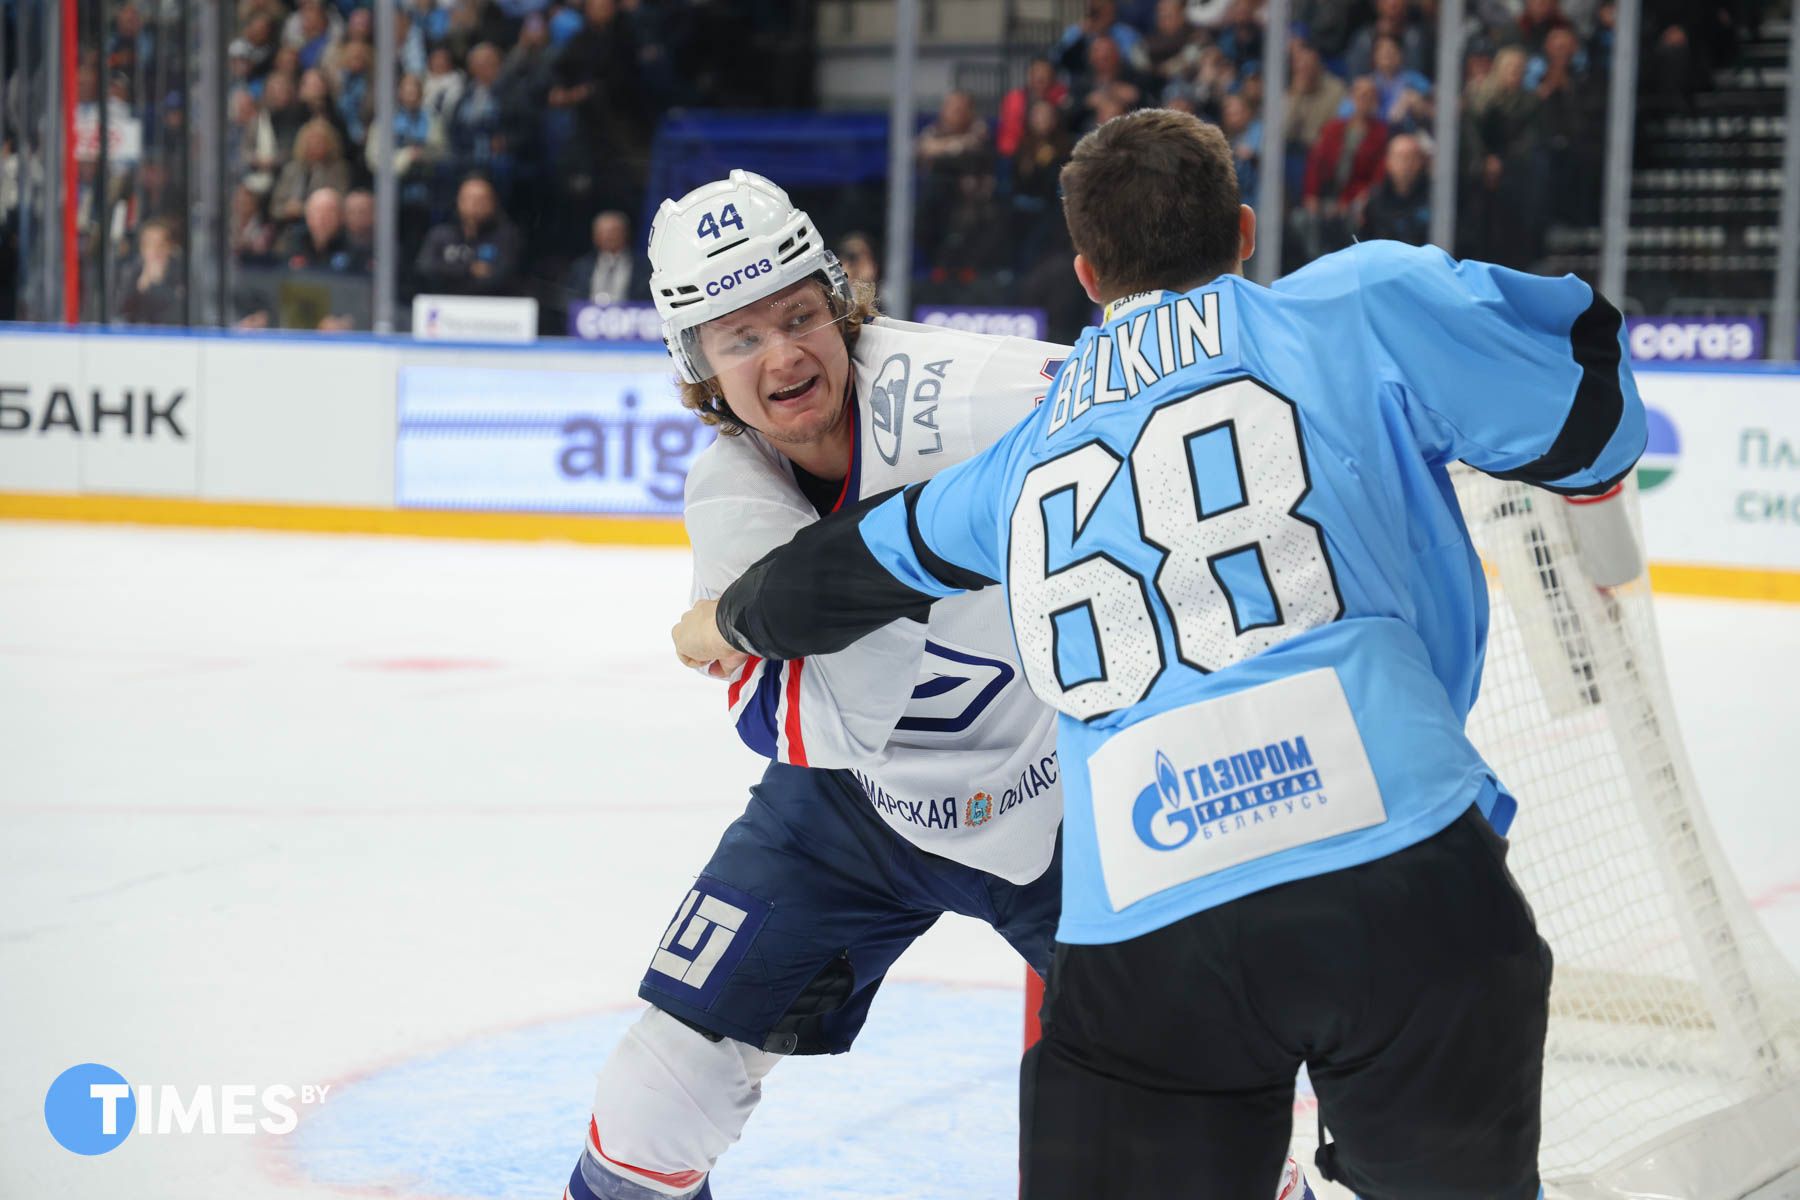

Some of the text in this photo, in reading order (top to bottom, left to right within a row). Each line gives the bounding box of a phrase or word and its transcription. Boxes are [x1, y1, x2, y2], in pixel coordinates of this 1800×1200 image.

[696, 203, 745, 240] 44
[705, 257, 773, 297] согаз
[576, 306, 666, 340] сога
[1630, 323, 1754, 361] согаз
[1046, 291, 1224, 440] BELKIN
[0, 387, 186, 437] БАНК
[912, 358, 954, 456] LADA
[558, 391, 700, 503] aig
[1007, 375, 1347, 724] 68
[1183, 735, 1315, 802] ГАЗПРОМ
[1198, 772, 1320, 823] ТРАНСГАЗ
[1202, 792, 1329, 841] БЕЛАРУСЬ
